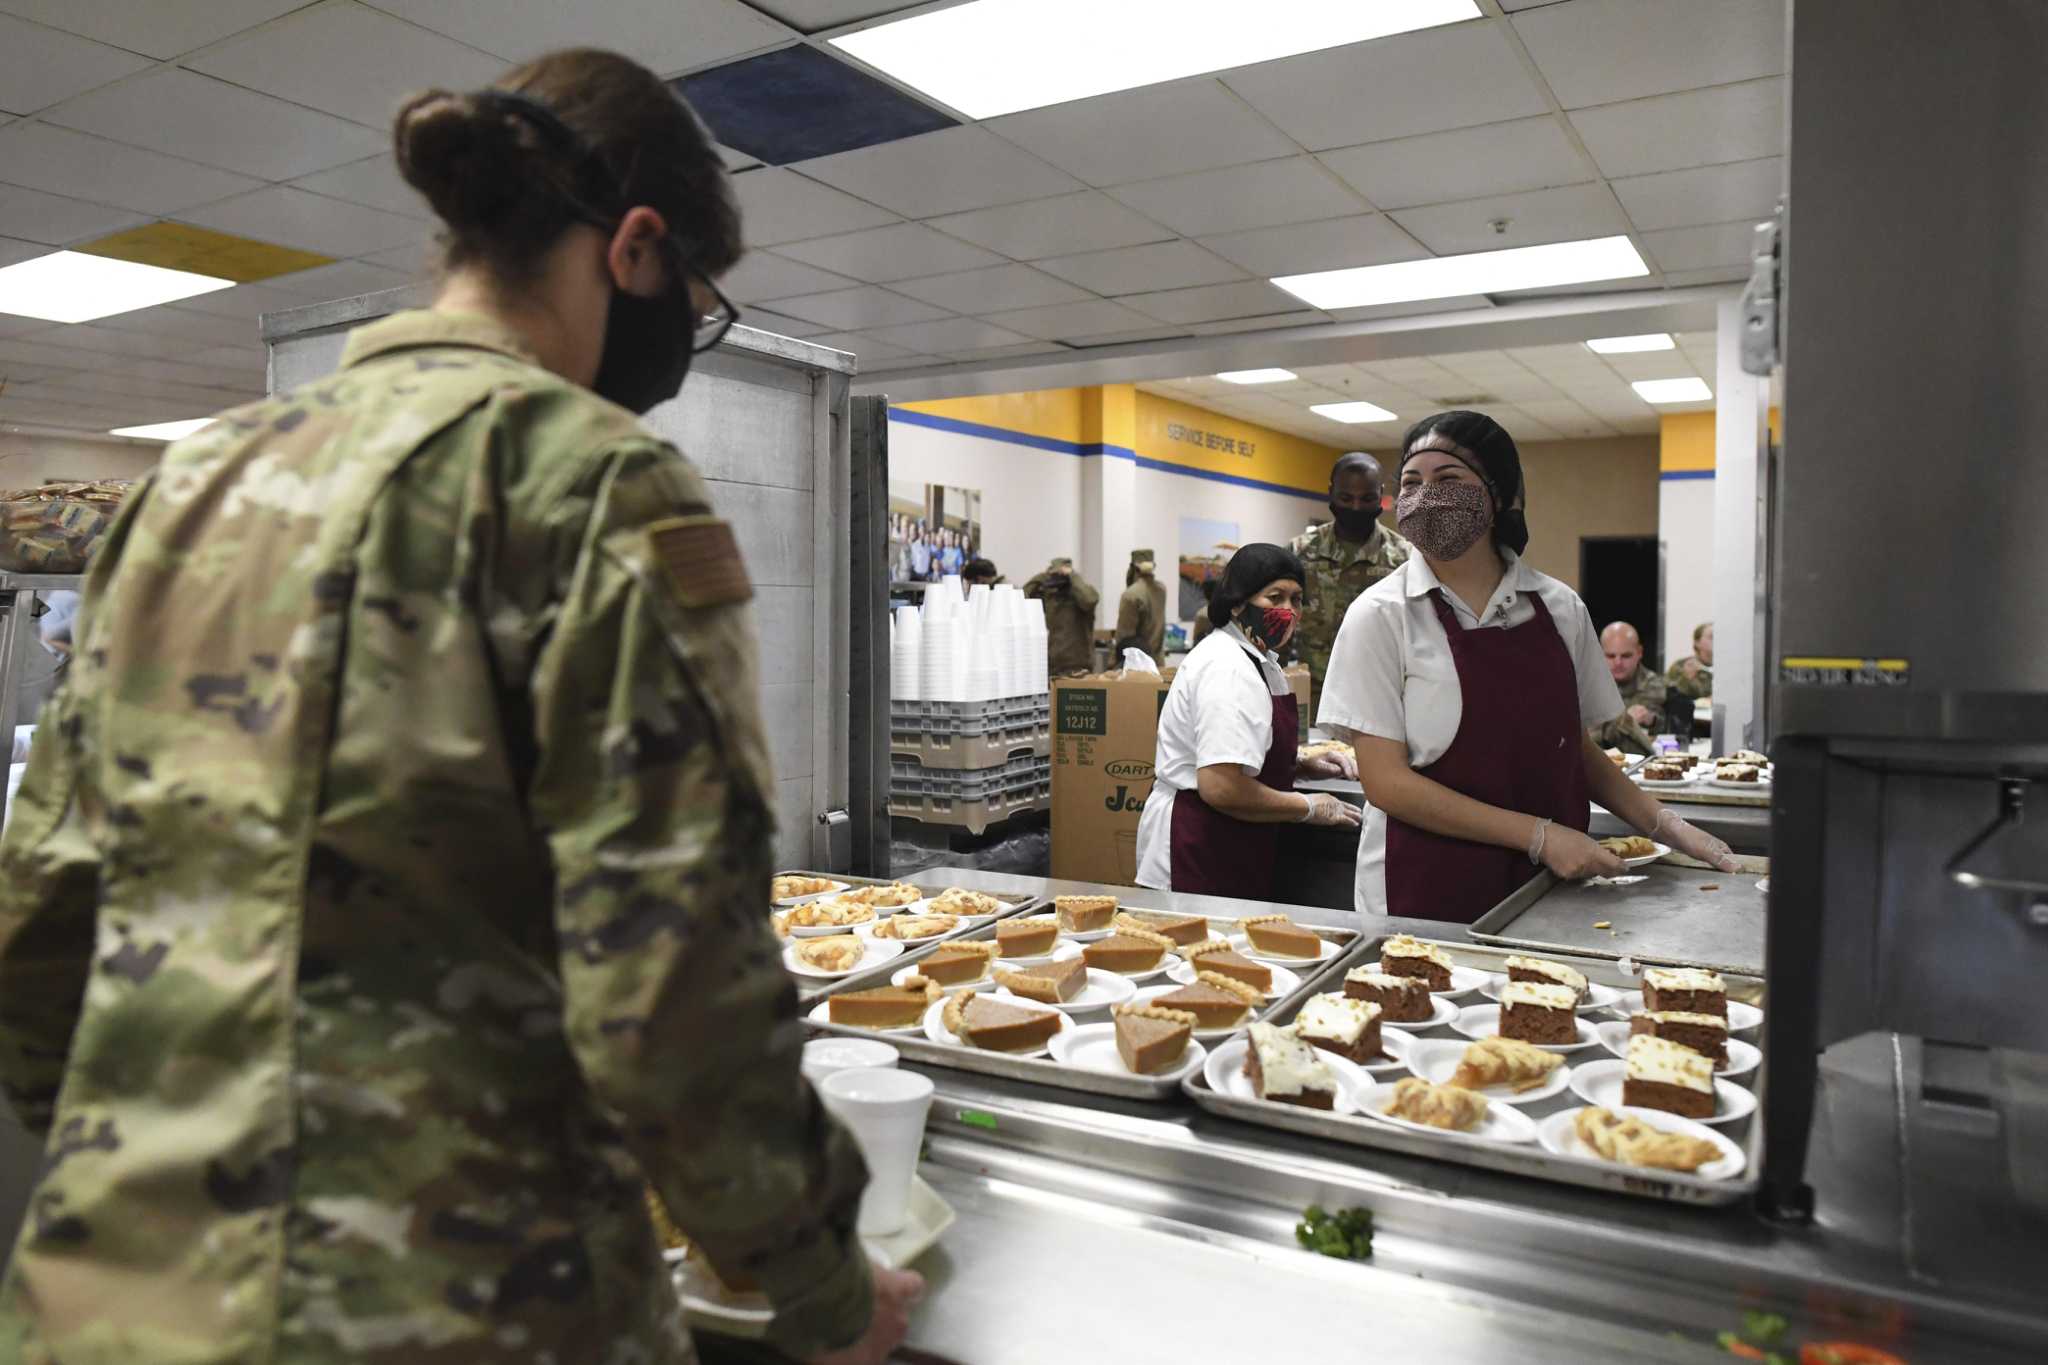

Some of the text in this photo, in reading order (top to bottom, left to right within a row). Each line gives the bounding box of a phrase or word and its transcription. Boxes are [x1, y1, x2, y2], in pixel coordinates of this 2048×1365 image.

[1167, 423, 1256, 458] SERVICE BEFORE SELF
[1065, 716, 1097, 729] 12J12
[1111, 764, 1150, 776] DART
